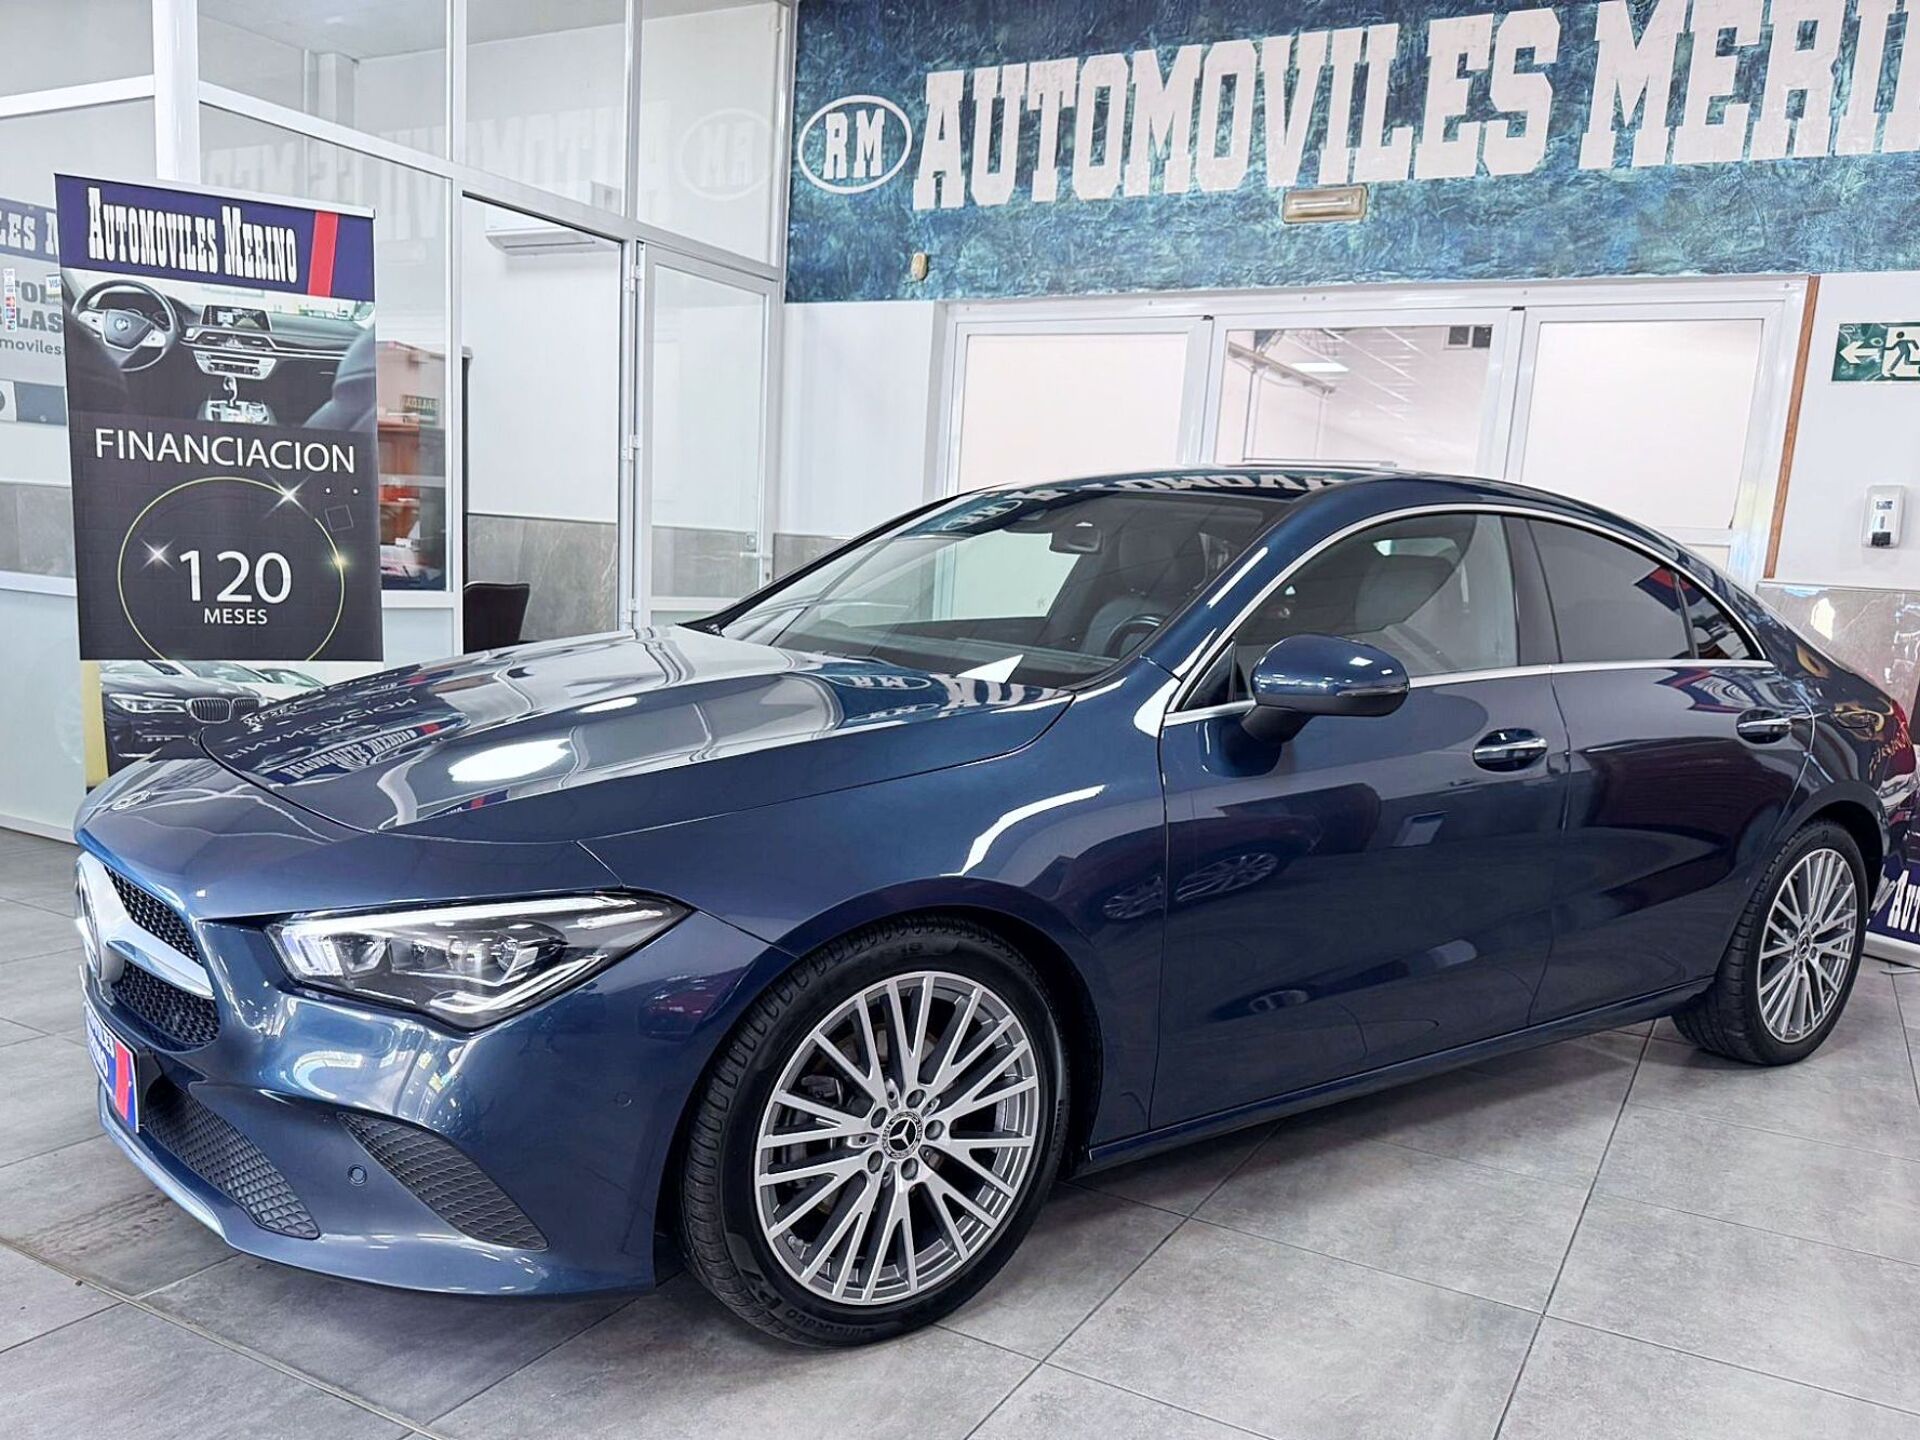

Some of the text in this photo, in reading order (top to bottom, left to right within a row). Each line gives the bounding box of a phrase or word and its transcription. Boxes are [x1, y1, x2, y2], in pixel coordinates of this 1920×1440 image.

[913, 8, 1561, 210] AUTOMOVILES
[222, 206, 297, 284] MERINO
[95, 428, 356, 474] FINANCIACION
[179, 550, 292, 604] 120
[203, 608, 268, 625] MESES
[1887, 870, 1920, 933] AUT
